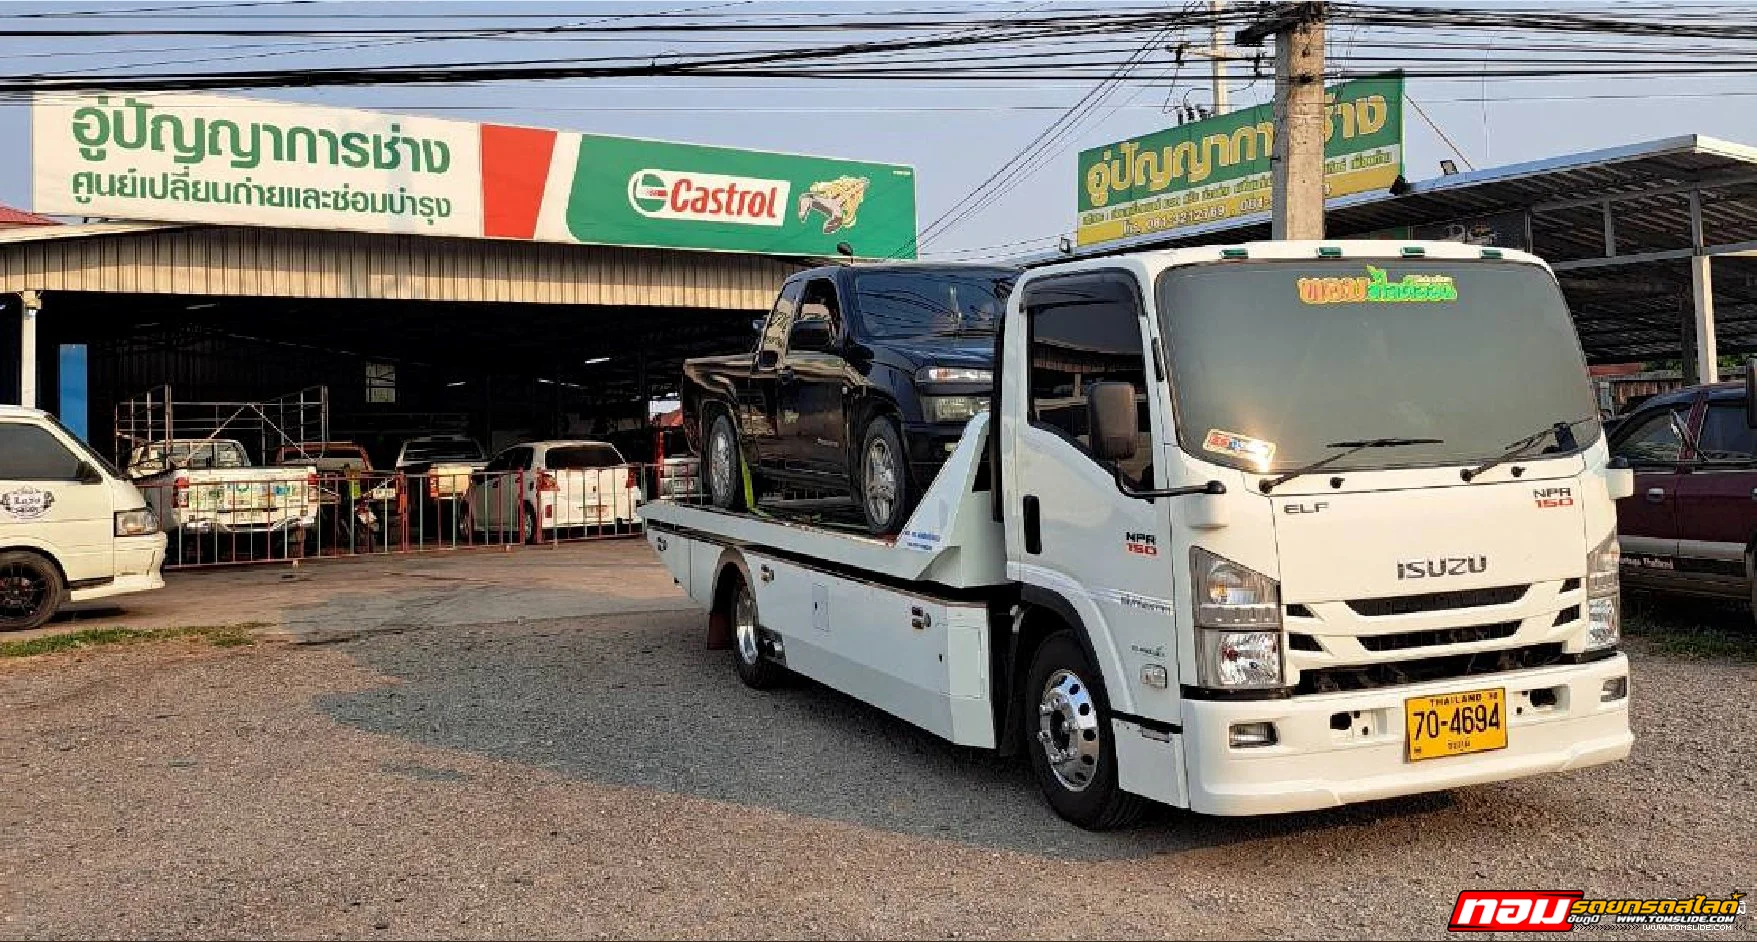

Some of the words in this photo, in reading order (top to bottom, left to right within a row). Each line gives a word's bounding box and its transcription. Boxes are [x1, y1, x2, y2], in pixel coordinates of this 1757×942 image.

[72, 96, 451, 174] อู่ปัญญาการช่าง
[72, 166, 451, 225] ศูนย์เปลี่ยนถ่ายและซ่อมบำรุง
[671, 178, 777, 218] Castrol
[1533, 487, 1571, 499] NPR
[1284, 501, 1329, 514] ELF
[1534, 498, 1573, 508] 150
[1126, 531, 1157, 546] NPR
[1126, 542, 1158, 556] 150
[1397, 555, 1487, 580] ISUZU
[1430, 693, 1482, 707] THAILAND
[1412, 702, 1501, 741] 70-4694
